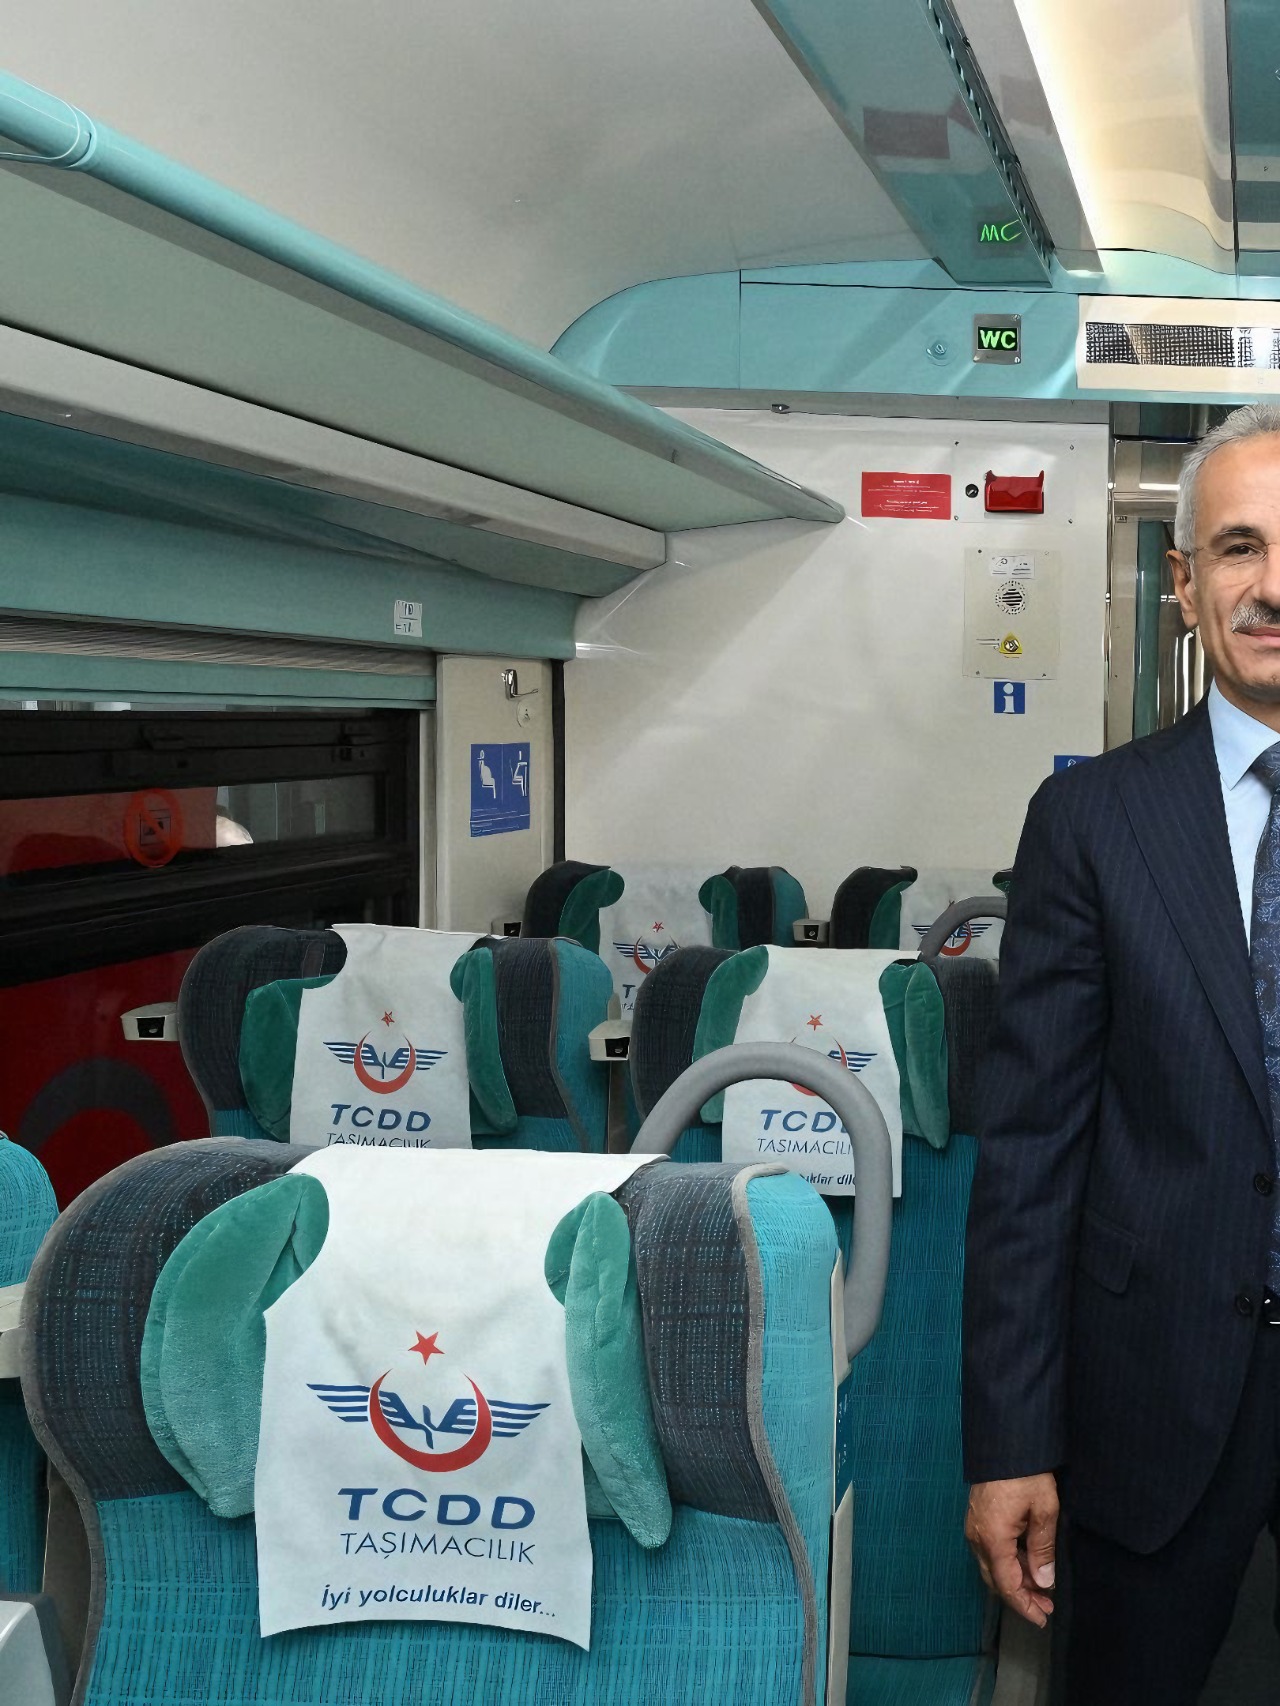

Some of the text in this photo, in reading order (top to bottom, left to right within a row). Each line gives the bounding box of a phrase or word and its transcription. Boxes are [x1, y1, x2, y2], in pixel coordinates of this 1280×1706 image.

[979, 329, 1017, 349] WC
[331, 1104, 431, 1132] TCDD
[761, 1109, 848, 1134] TCD
[337, 1487, 536, 1530] TCDD
[340, 1531, 537, 1565] TAŞIMACILIK
[359, 1584, 489, 1607] yolculuklar
[494, 1592, 556, 1617] diler...
